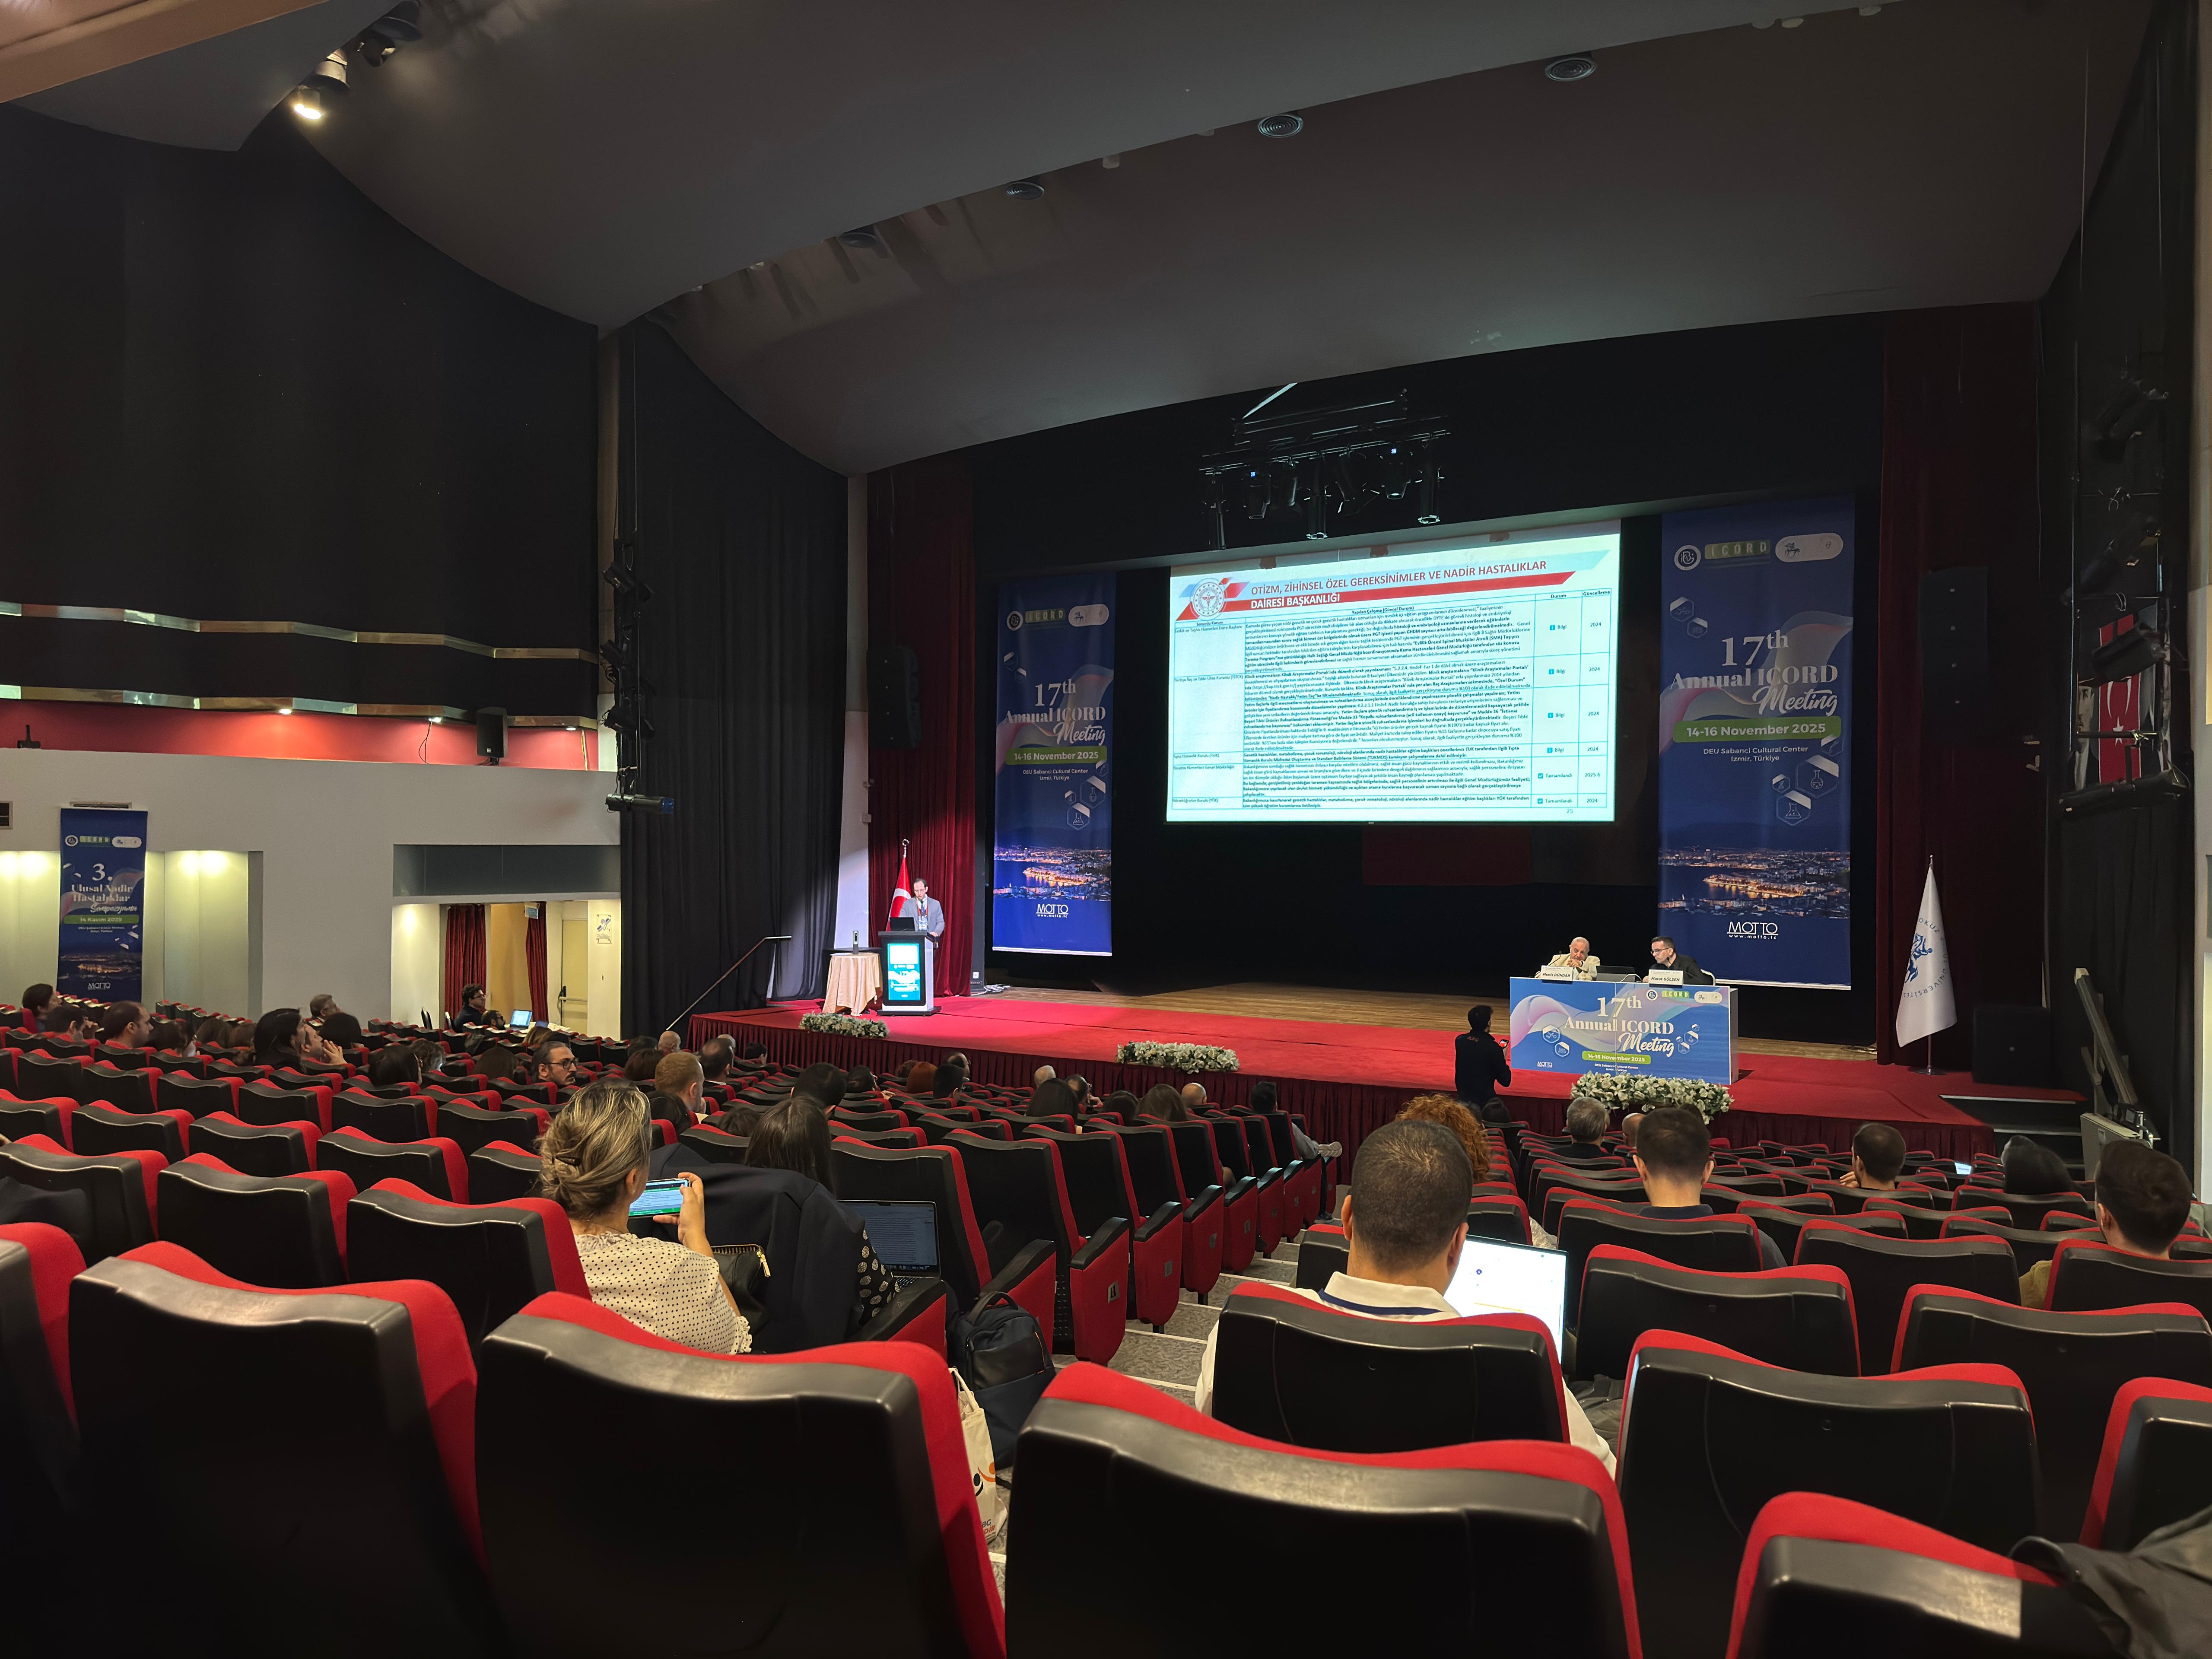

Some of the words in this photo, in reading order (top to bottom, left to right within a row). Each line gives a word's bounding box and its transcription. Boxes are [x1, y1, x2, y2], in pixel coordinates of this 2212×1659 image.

[1711, 542, 1767, 557] ICORD
[1252, 584, 1282, 595] OTİZM,
[1284, 581, 1323, 591] ZİHİNSEL
[1326, 578, 1348, 588] ÖZEL
[1350, 571, 1425, 586] GEREKSİNİMLER
[1428, 570, 1441, 579] VE
[1443, 565, 1475, 578] NADİR
[1478, 560, 1546, 575] HASTALIKLAR
[1251, 597, 1284, 608] DAİRESİ
[1287, 592, 1340, 606] BAŞKANLIĞI
[1722, 629, 1789, 666] 17th
[1671, 668, 1751, 689] Annual
[1757, 665, 1838, 686] ICORD
[1035, 679, 1076, 706] 17th
[1752, 684, 1838, 716] Meeting
[1005, 708, 1053, 723] Annual
[1057, 706, 1106, 722] ICORD
[1053, 721, 1106, 746] Meeting
[1687, 728, 1717, 737] 14-16
[1721, 725, 1789, 736] November
[1792, 724, 1826, 734] 2025
[1033, 752, 1075, 760] November
[1077, 751, 1098, 760] 2025
[1754, 755, 1780, 763] Türkiye
[92, 864, 113, 881] 3.
[1037, 904, 1068, 914] MOTTO
[1728, 922, 1778, 934] MOTTO
[1919, 918, 1939, 933] OKUZ
[1597, 995, 1642, 1017] 17th
[1565, 1017, 1618, 1031] Annual
[1621, 1020, 1674, 1034] ICORD
[1618, 1032, 1674, 1057] Meeting
[1110, 1284, 1116, 1299] H
